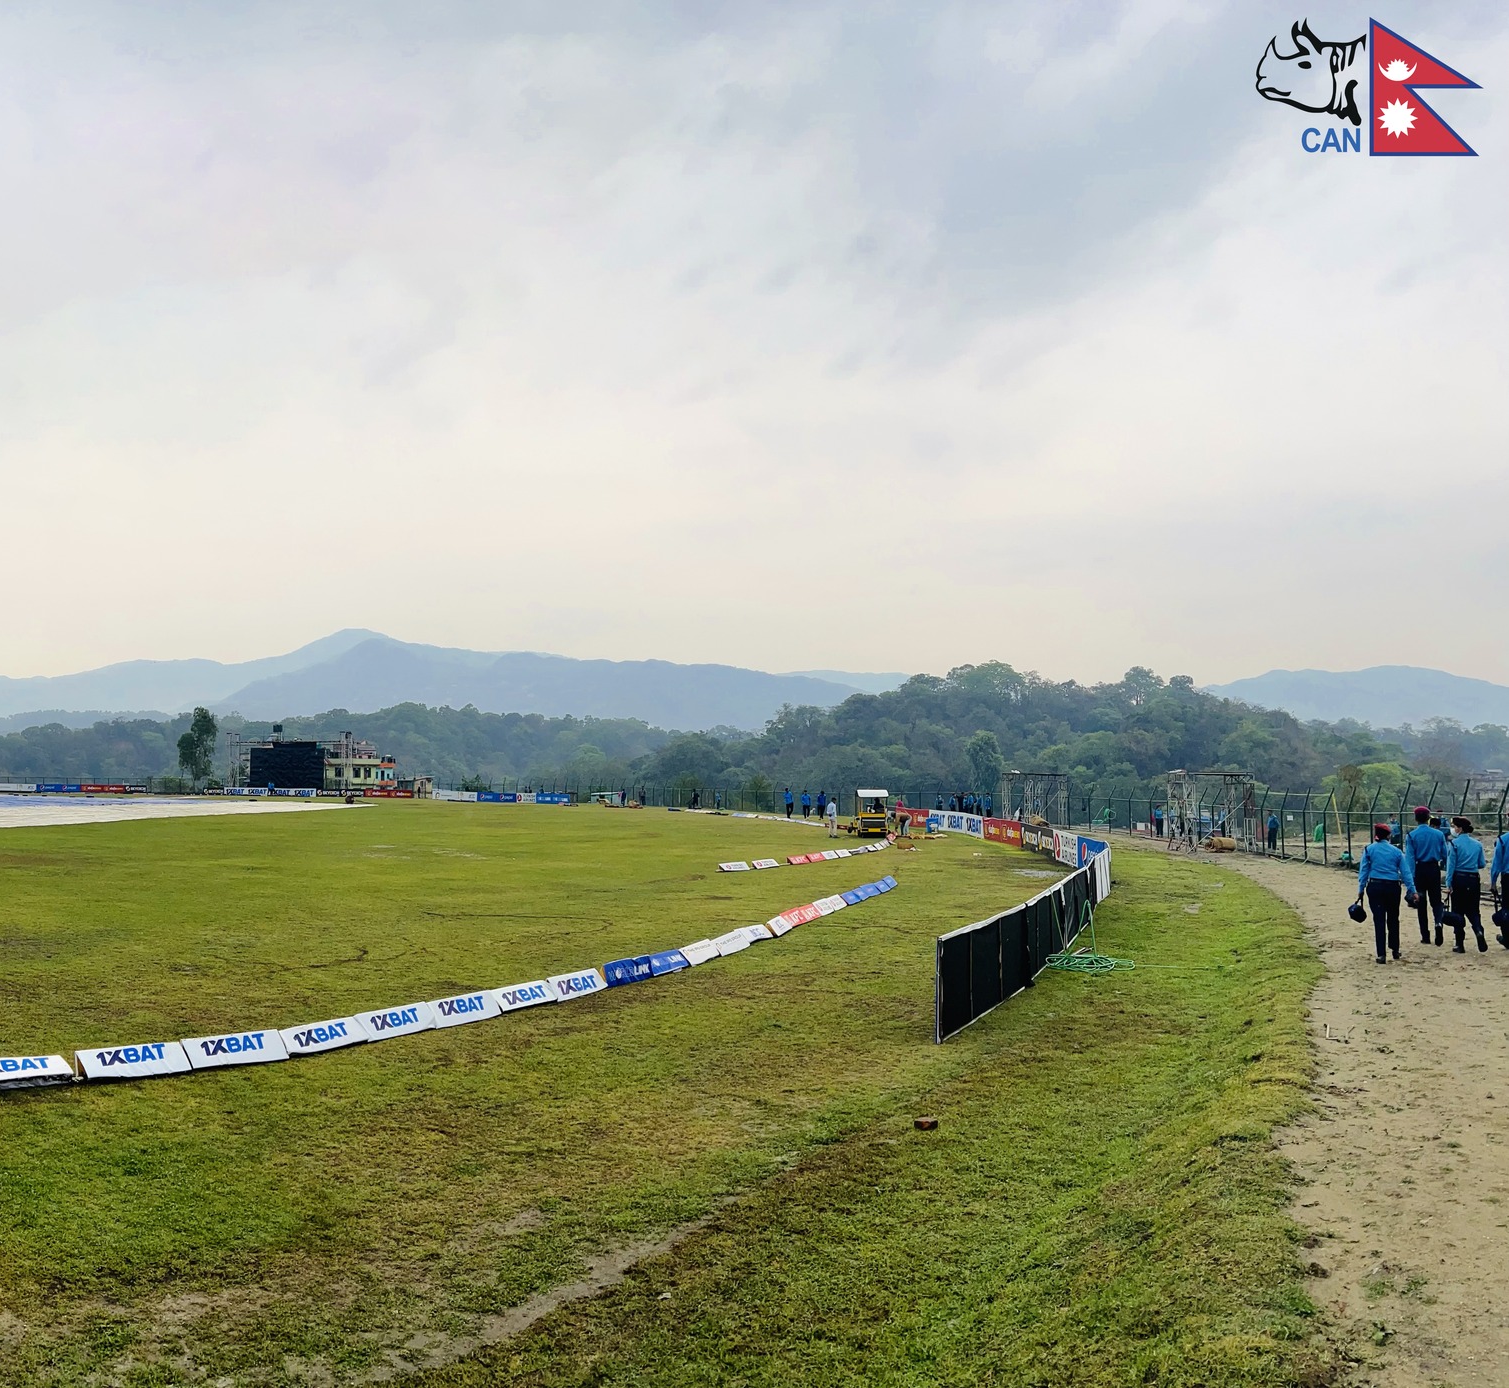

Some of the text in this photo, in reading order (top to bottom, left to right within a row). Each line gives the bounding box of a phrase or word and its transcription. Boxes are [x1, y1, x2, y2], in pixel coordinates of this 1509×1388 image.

[294, 789, 314, 797] 1XBAT
[502, 984, 547, 1005] 1XBAT
[557, 974, 597, 996] 1XBAT
[437, 995, 485, 1016] 1XBAT
[370, 1007, 420, 1031] 1XBAT
[200, 1033, 264, 1056] 1XBAT
[293, 1021, 347, 1047] 1XBAT
[96, 1042, 165, 1067] 1XBAT
